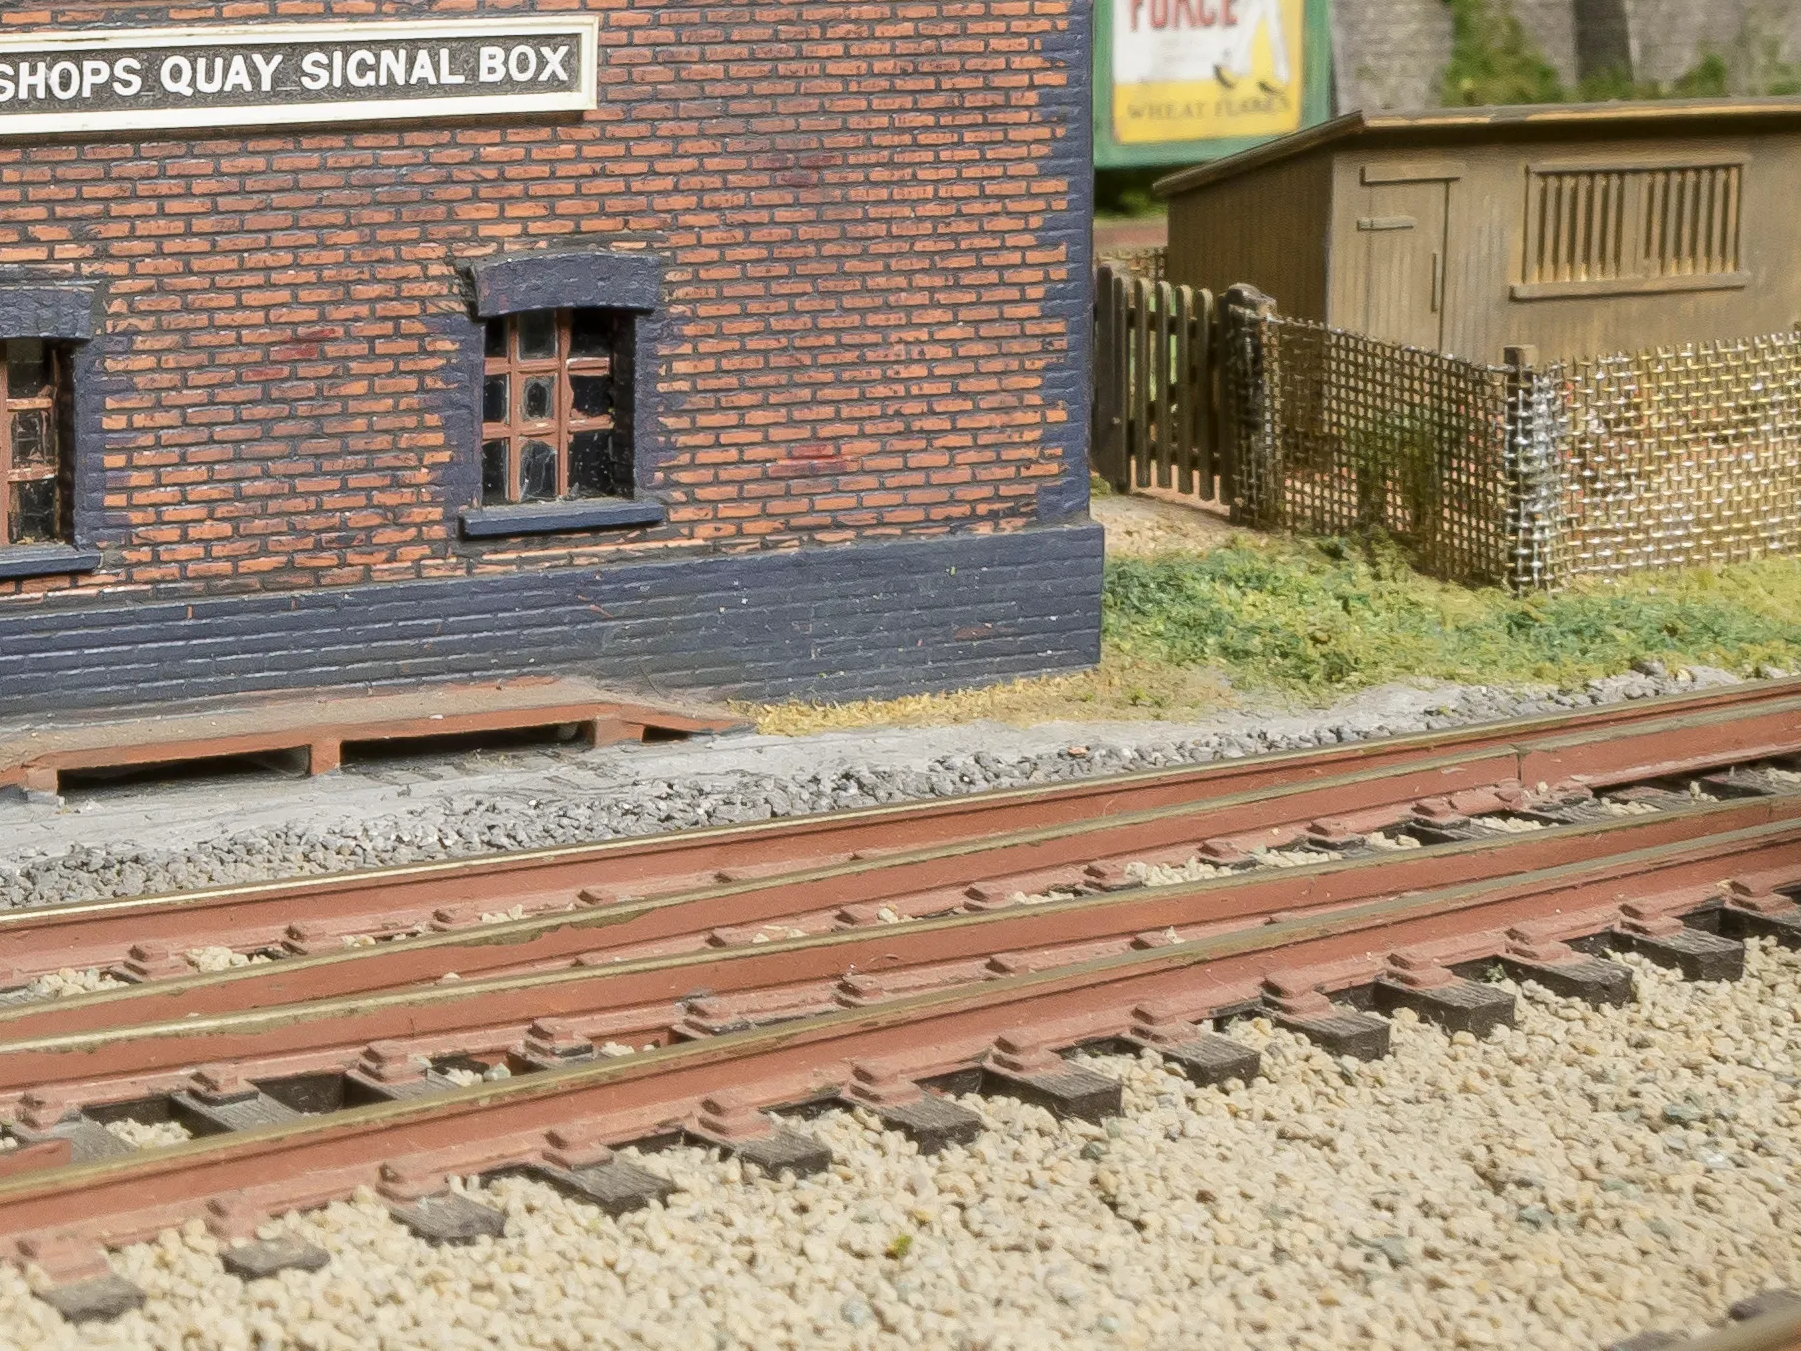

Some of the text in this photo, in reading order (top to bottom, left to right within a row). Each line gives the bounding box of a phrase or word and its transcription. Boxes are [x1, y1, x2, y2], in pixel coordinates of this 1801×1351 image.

[160, 53, 283, 97] QUAY
[300, 47, 465, 90] SIGNAL
[479, 44, 570, 84] BOX
[1127, 100, 1205, 120] WHEAT
